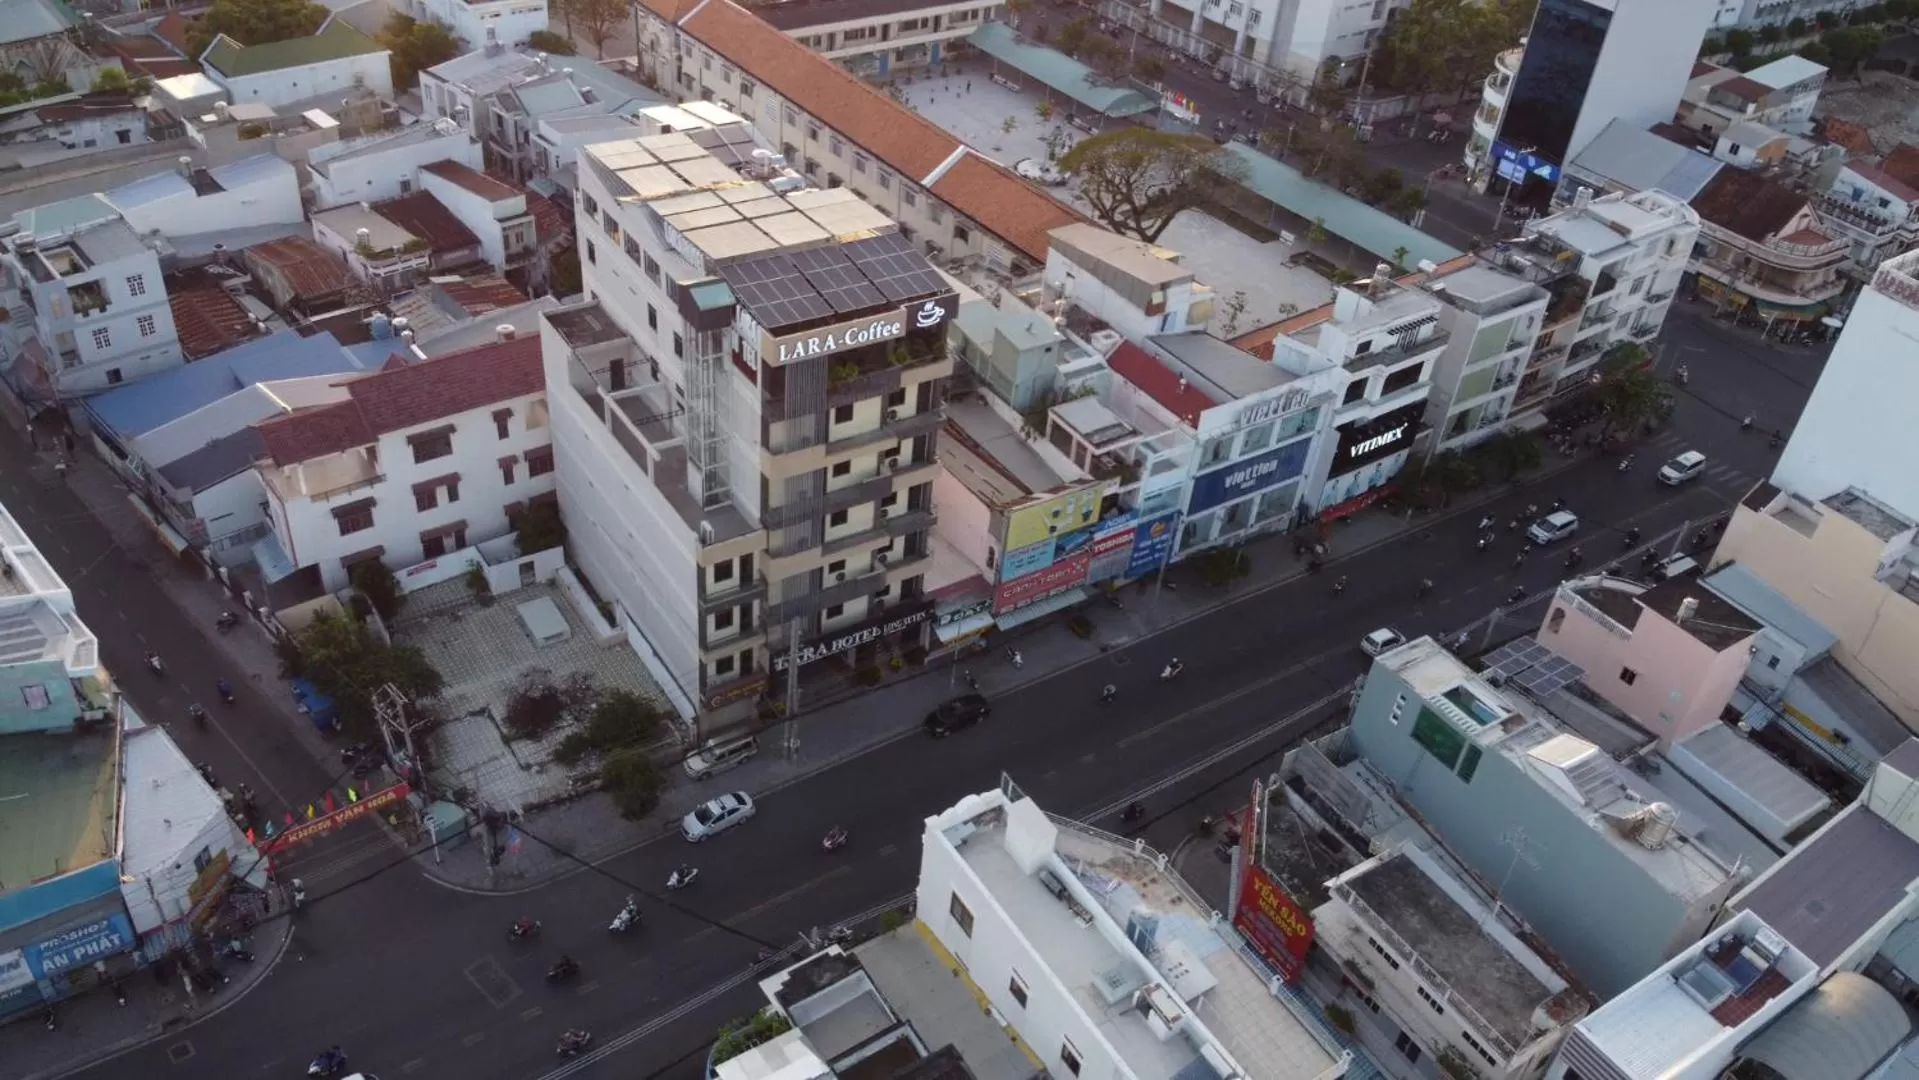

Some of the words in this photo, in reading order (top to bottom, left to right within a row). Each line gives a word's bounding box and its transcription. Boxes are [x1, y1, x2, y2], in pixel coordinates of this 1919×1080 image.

[779, 320, 901, 362] LARA-Coffee
[1350, 424, 1407, 459] VITIMEX
[832, 626, 881, 652] HOTEL
[42, 953, 70, 973] AN
